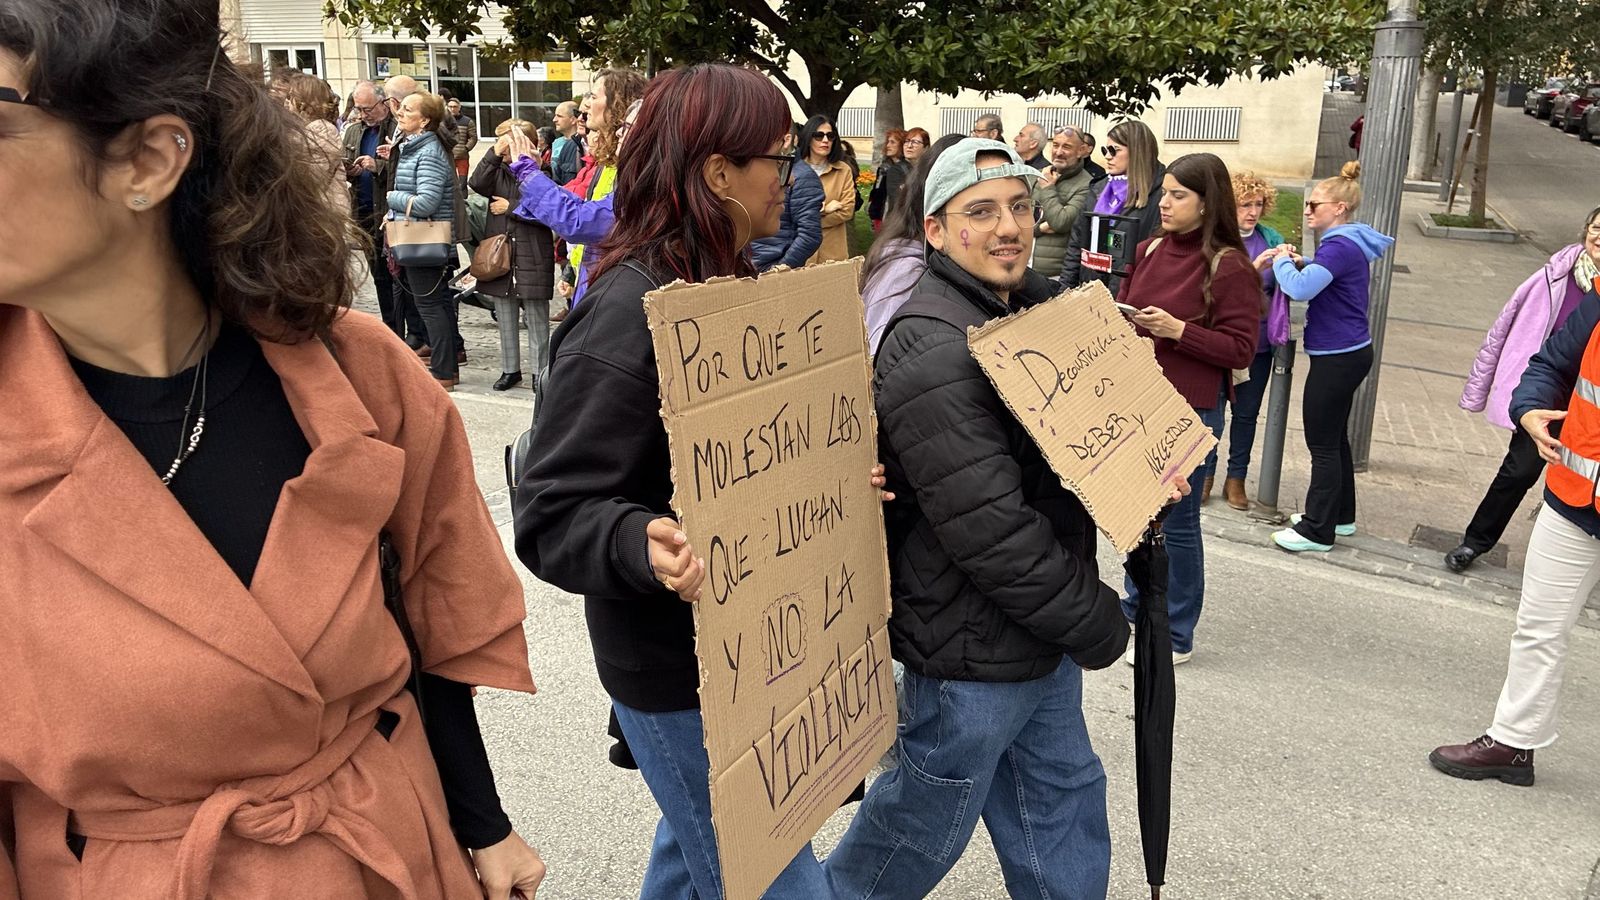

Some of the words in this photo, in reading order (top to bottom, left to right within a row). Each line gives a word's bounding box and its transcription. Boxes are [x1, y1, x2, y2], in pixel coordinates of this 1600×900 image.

[742, 318, 788, 381] QUÉ
[797, 309, 823, 363] TE
[1094, 377, 1115, 398] es
[693, 402, 811, 502] MOLESTAN
[1065, 412, 1129, 461] DEBER
[709, 534, 753, 605] QUE
[723, 632, 742, 704] Y
[767, 602, 802, 677] NO
[824, 562, 855, 631] LA
